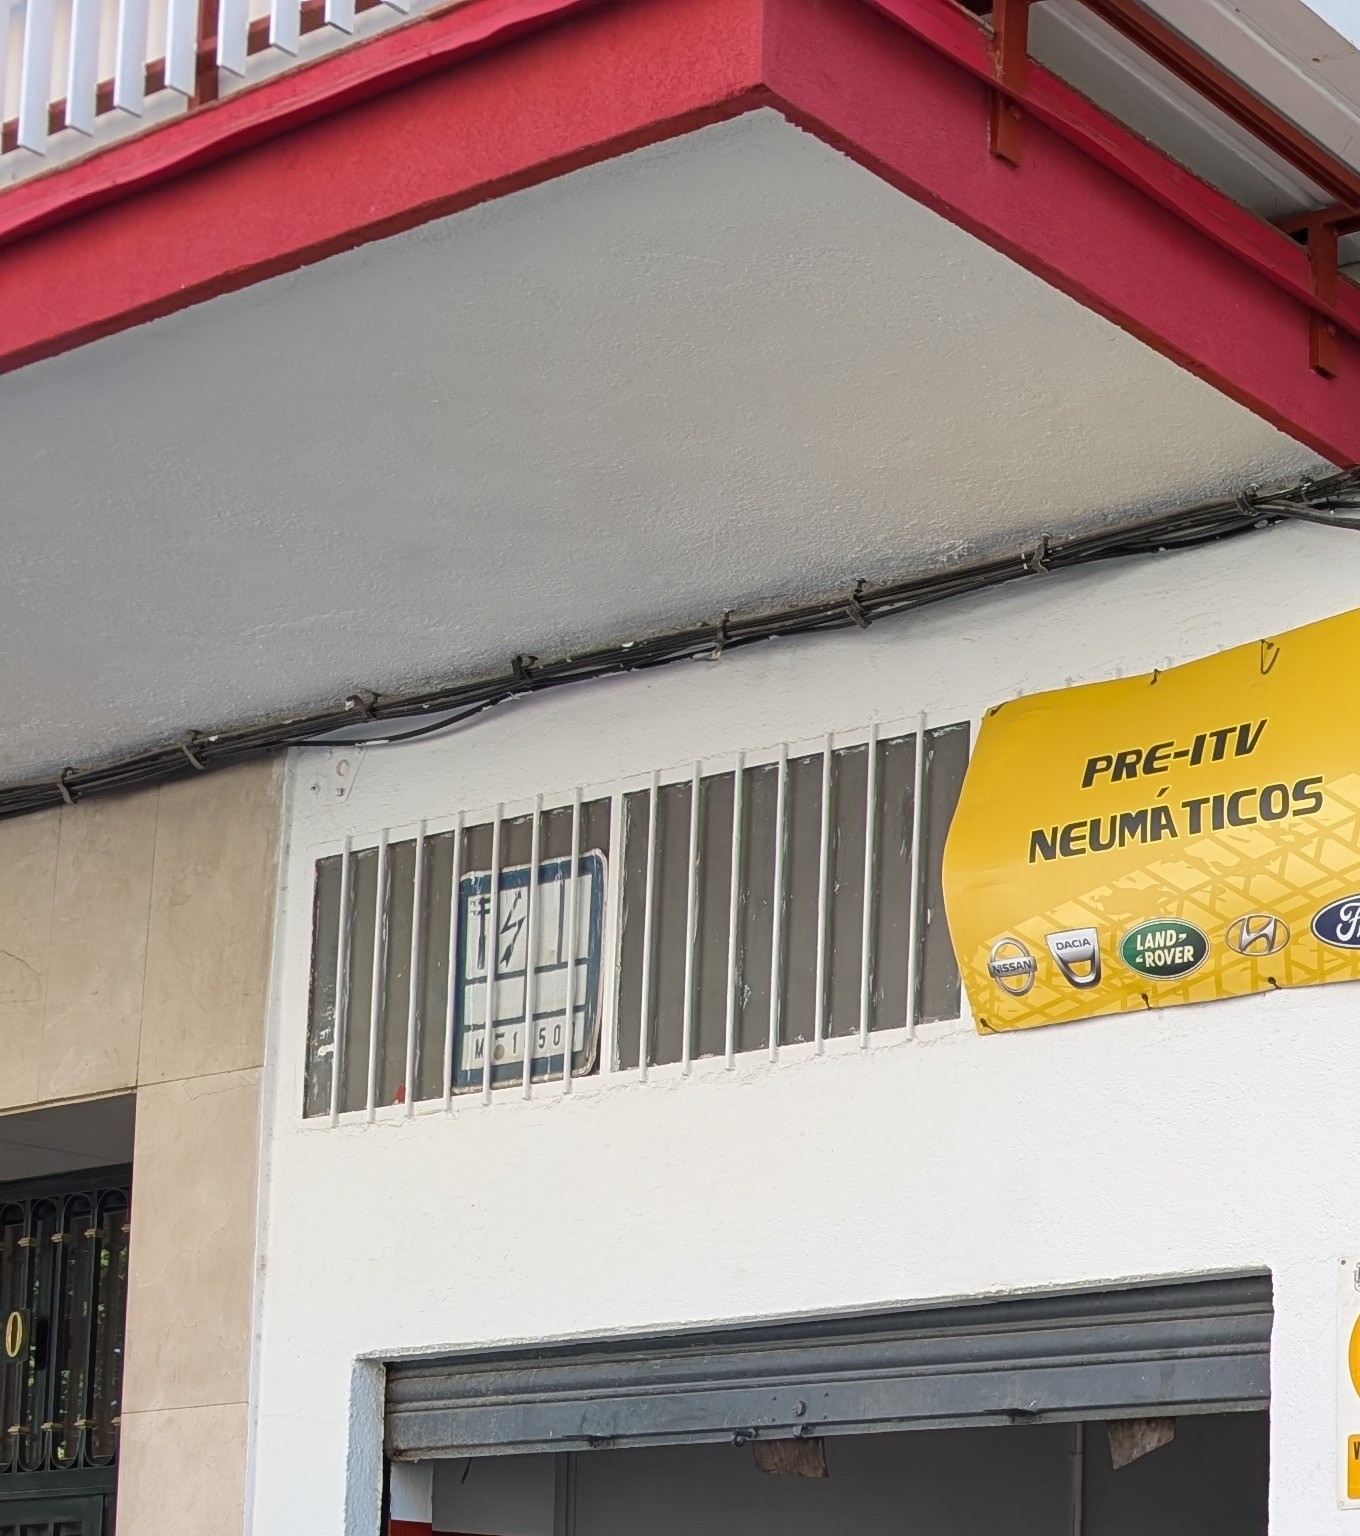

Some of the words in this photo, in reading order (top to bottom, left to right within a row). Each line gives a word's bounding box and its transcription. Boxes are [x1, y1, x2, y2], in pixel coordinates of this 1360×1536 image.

[1081, 718, 1268, 789] PRE-ITV
[1055, 937, 1092, 951] DACIA
[992, 959, 1032, 974] NISSAN
